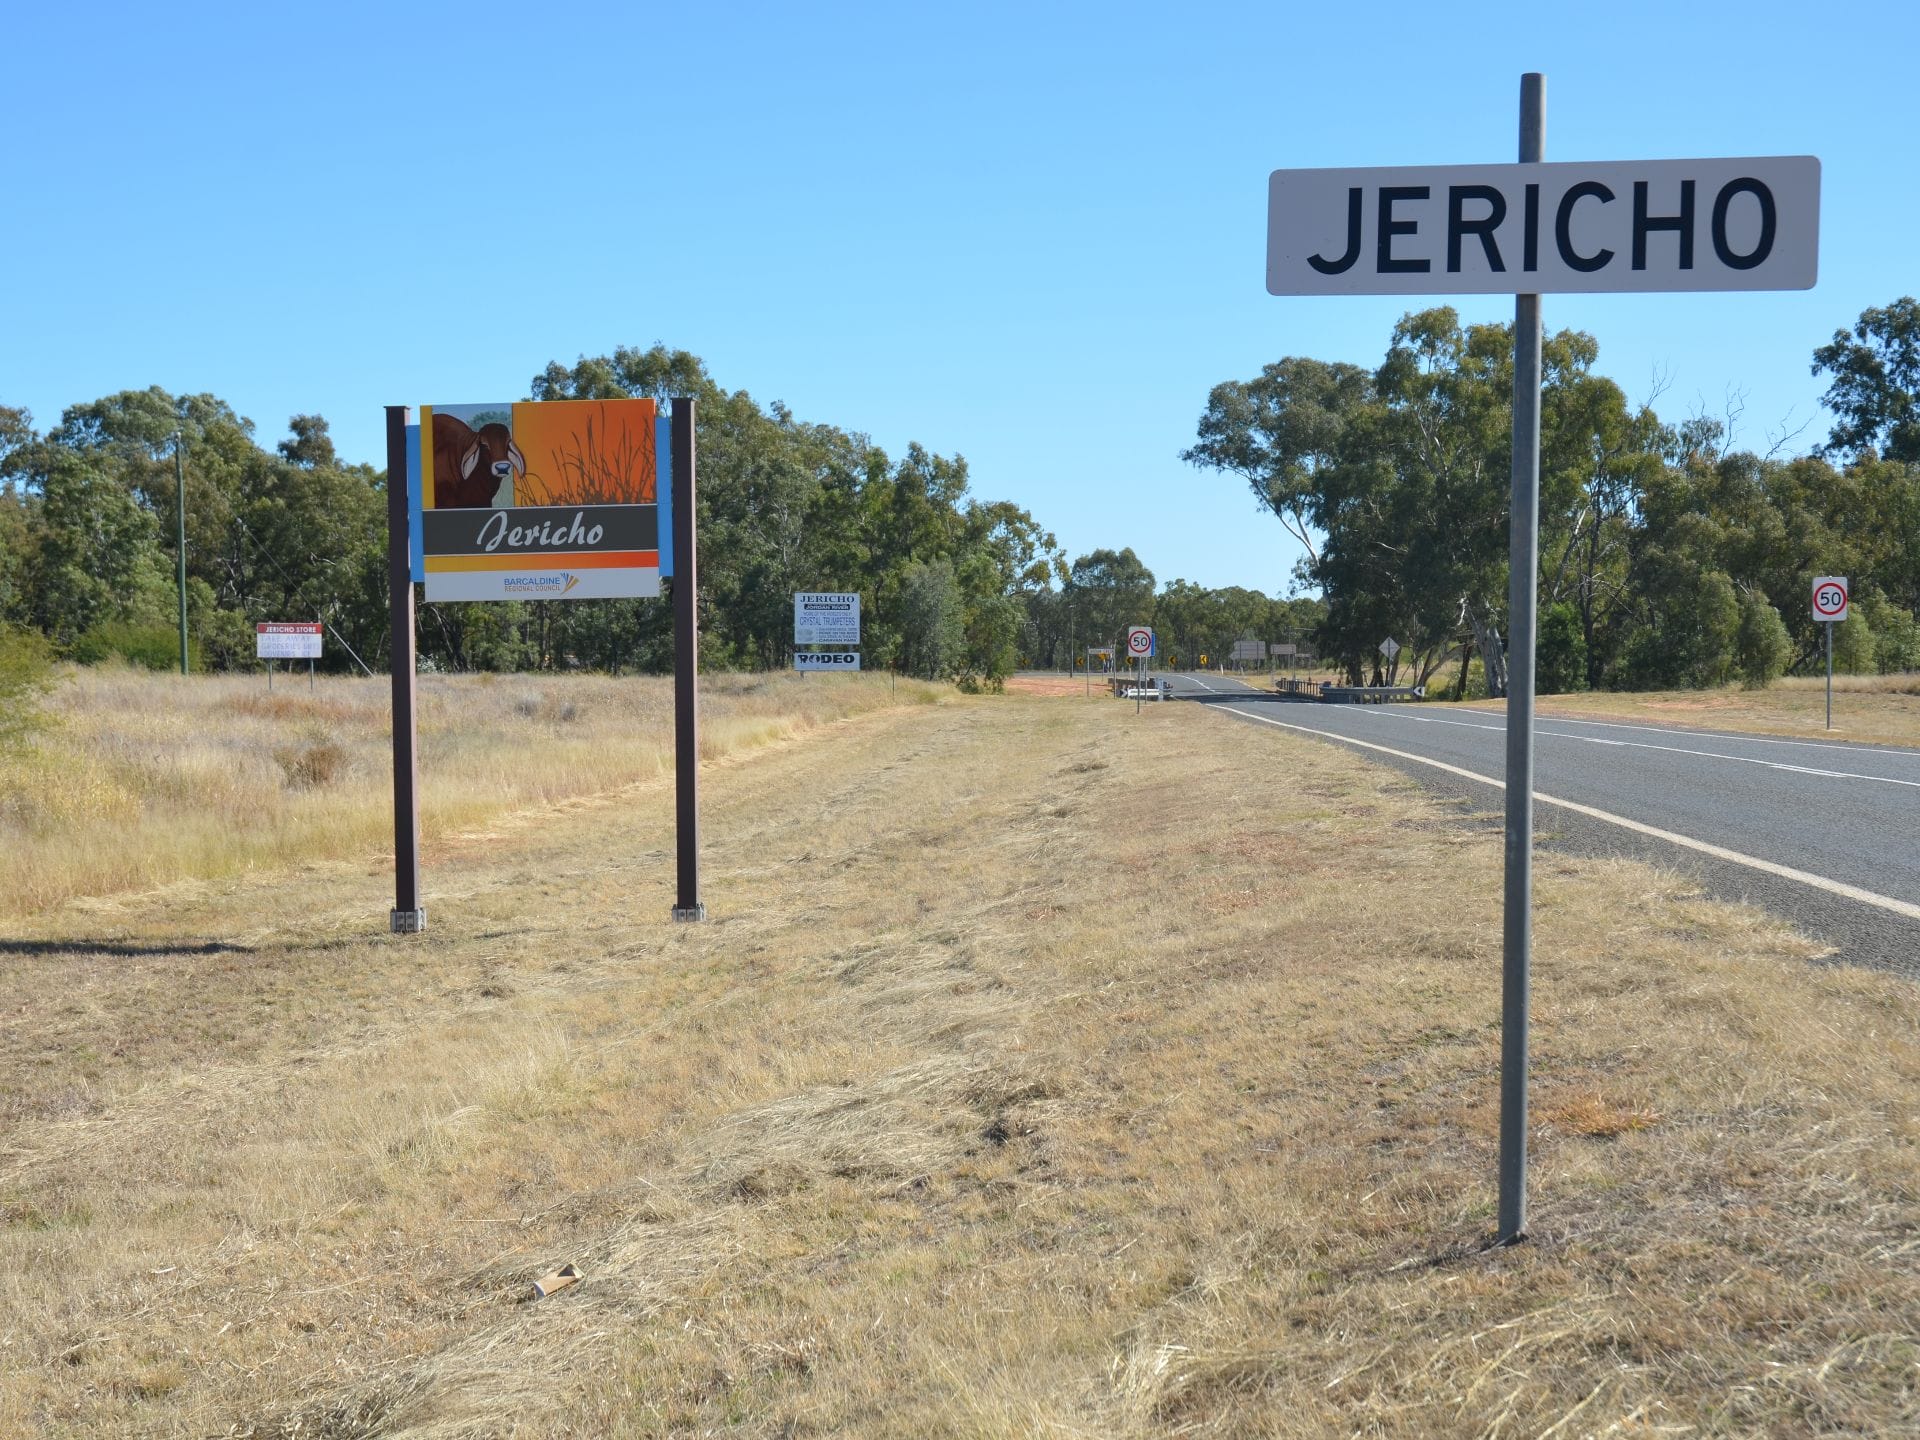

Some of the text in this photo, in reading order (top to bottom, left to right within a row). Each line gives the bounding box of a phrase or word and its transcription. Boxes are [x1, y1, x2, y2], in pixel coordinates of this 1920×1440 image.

[1306, 177, 1777, 275] JERICHO
[476, 511, 604, 552] Jericho
[503, 577, 561, 586] BARCALDINE
[535, 584, 561, 592] COUNCIL
[800, 595, 855, 603] JERICHO
[1820, 592, 1842, 606] 50
[1133, 636, 1148, 647] 50
[797, 654, 855, 664] RODEO
